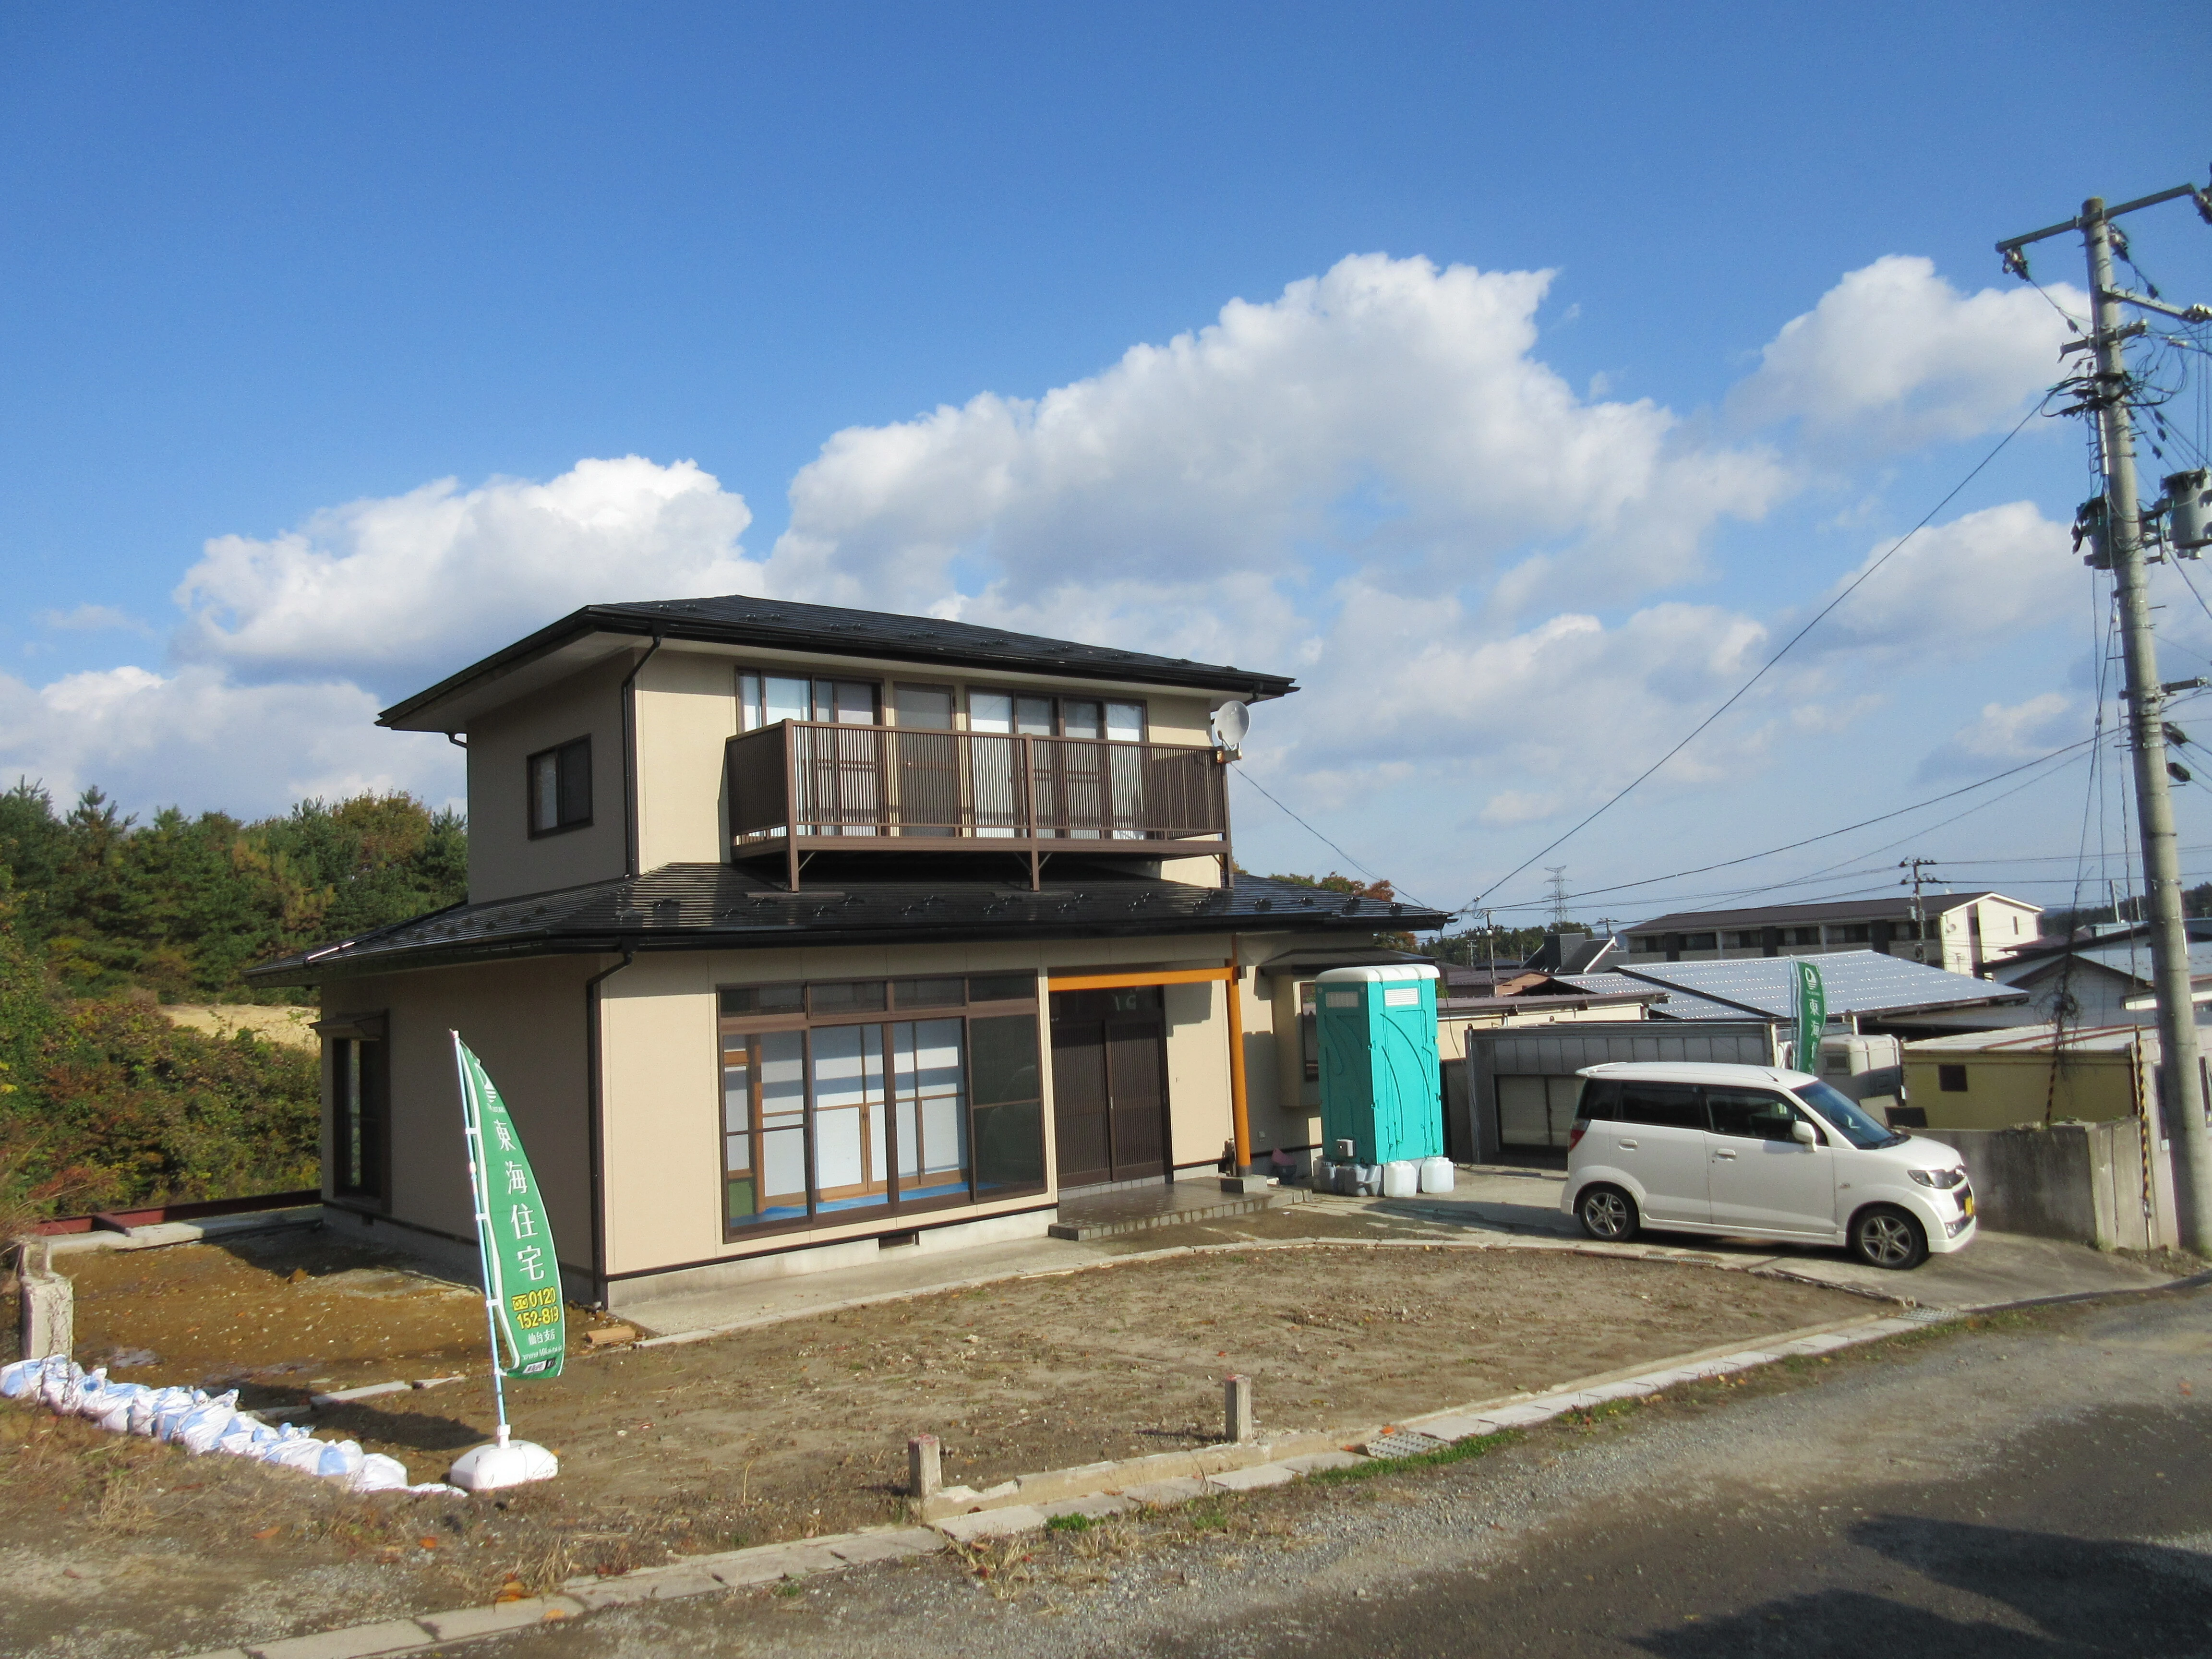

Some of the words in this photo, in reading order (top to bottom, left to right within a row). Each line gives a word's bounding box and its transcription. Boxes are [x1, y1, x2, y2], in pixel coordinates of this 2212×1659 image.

[493, 1119, 544, 1281] 東海住宅
[529, 1286, 556, 1308] 0120
[517, 1306, 559, 1329] 152-819
